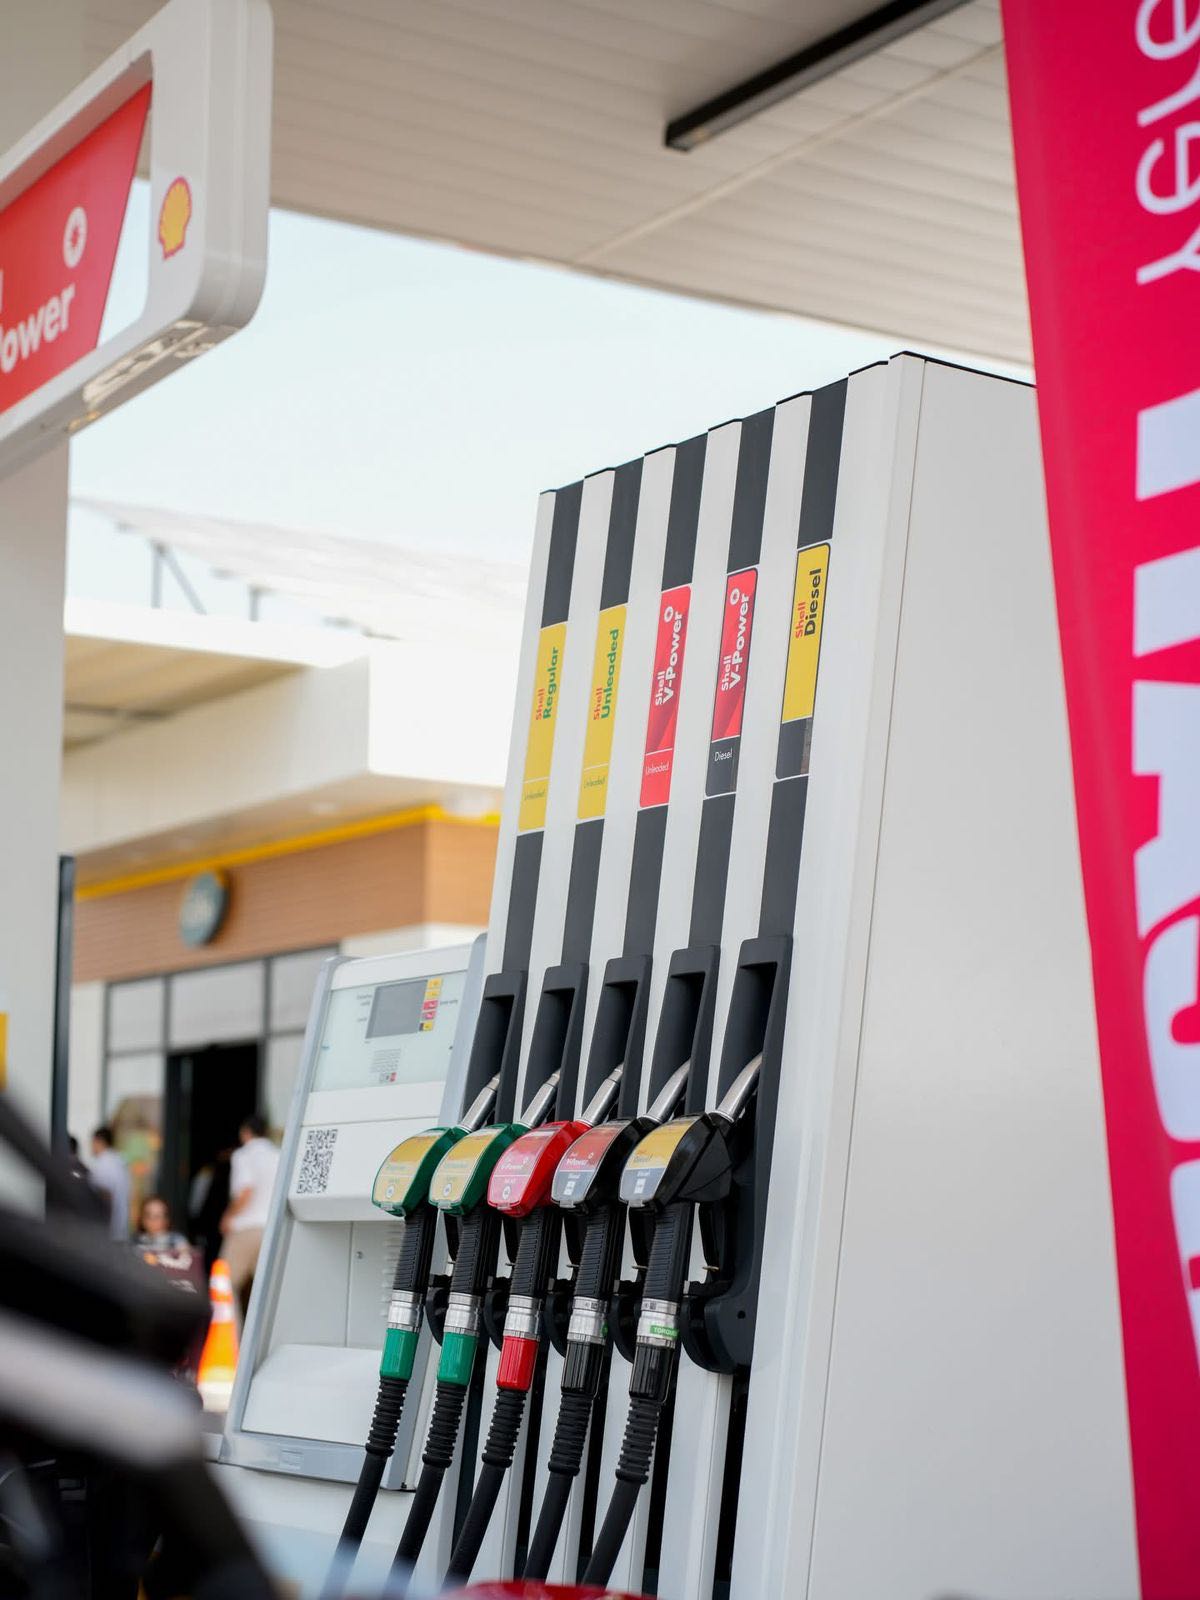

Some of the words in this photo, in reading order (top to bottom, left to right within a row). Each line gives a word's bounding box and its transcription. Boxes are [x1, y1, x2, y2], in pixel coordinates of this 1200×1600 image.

[0, 283, 76, 373] ower
[795, 601, 806, 639] Shell
[804, 567, 822, 636] Diesel
[662, 611, 683, 704] V-Power
[729, 593, 750, 689] V-Power
[543, 646, 559, 720] Regular
[600, 628, 619, 719] Unleaded
[655, 671, 666, 706] Shell
[722, 655, 732, 691] Shell
[536, 688, 545, 720] Shell
[594, 687, 603, 720] Shell
[646, 760, 670, 775] Unleaded
[714, 748, 733, 762] Diesel
